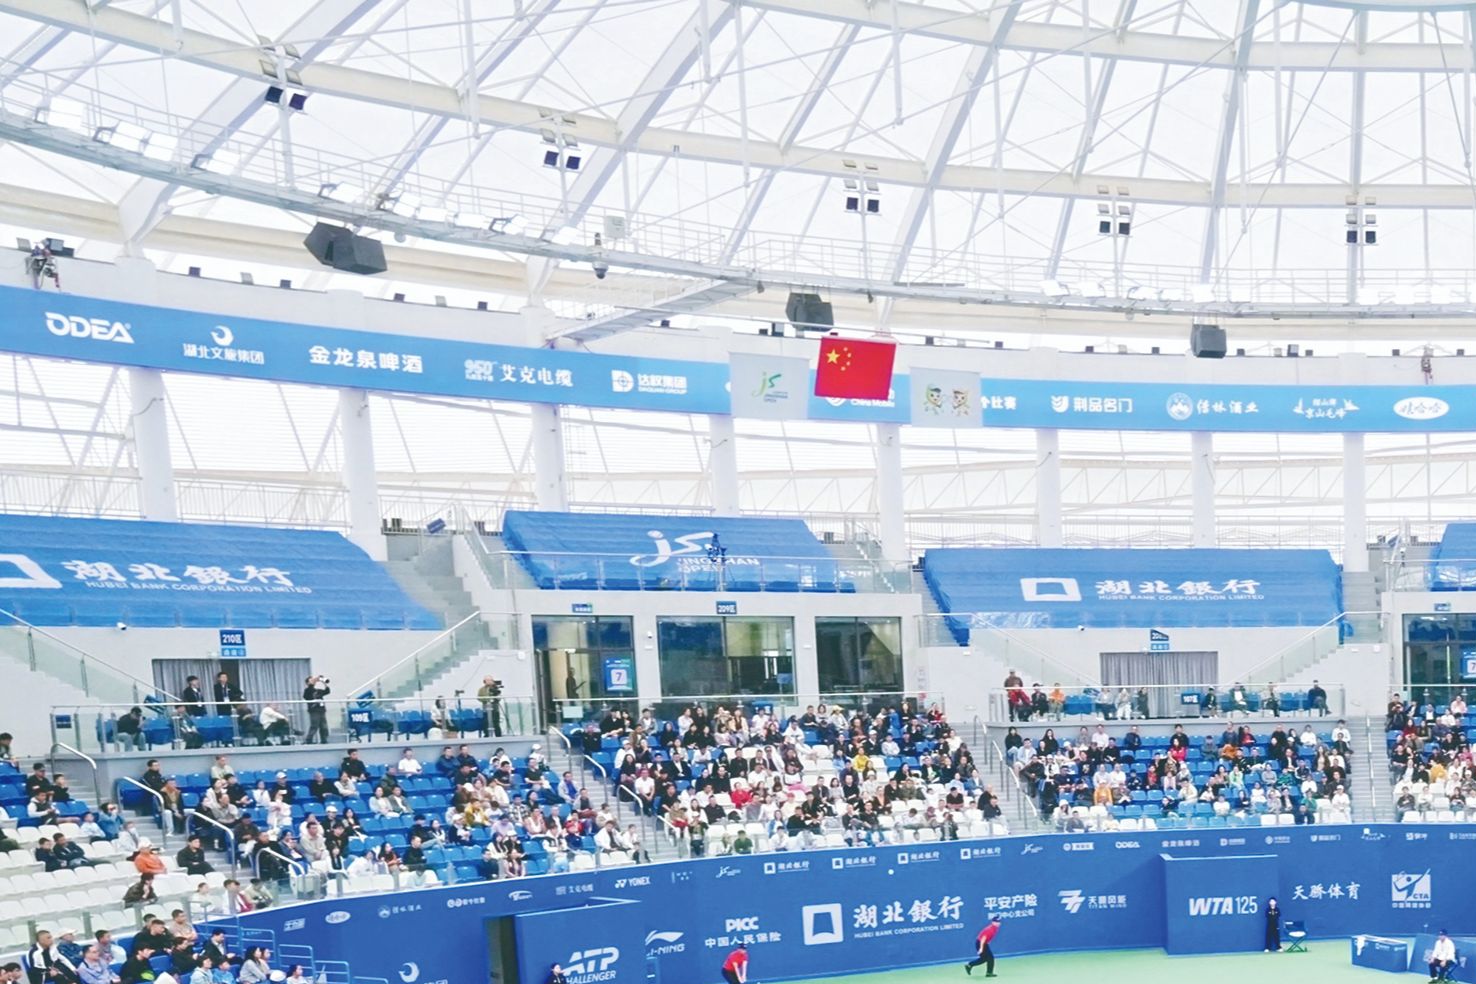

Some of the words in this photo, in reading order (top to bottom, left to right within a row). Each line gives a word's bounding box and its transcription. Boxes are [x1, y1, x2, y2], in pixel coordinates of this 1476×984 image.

[45, 312, 134, 343] ODEA
[309, 345, 423, 373] 金龙泉啤酒
[130, 582, 169, 591] BANK
[172, 583, 262, 593] CORPORATION
[265, 585, 312, 594] LIMITED
[629, 877, 650, 886] YONEX
[1292, 882, 1361, 900] 天骄体育
[984, 894, 1037, 909] 平安产险
[1189, 898, 1233, 916] WTA
[1237, 896, 1257, 914] 125
[726, 917, 759, 932] PICC
[705, 933, 781, 949] 中国人民保险
[562, 947, 619, 975] ATP
